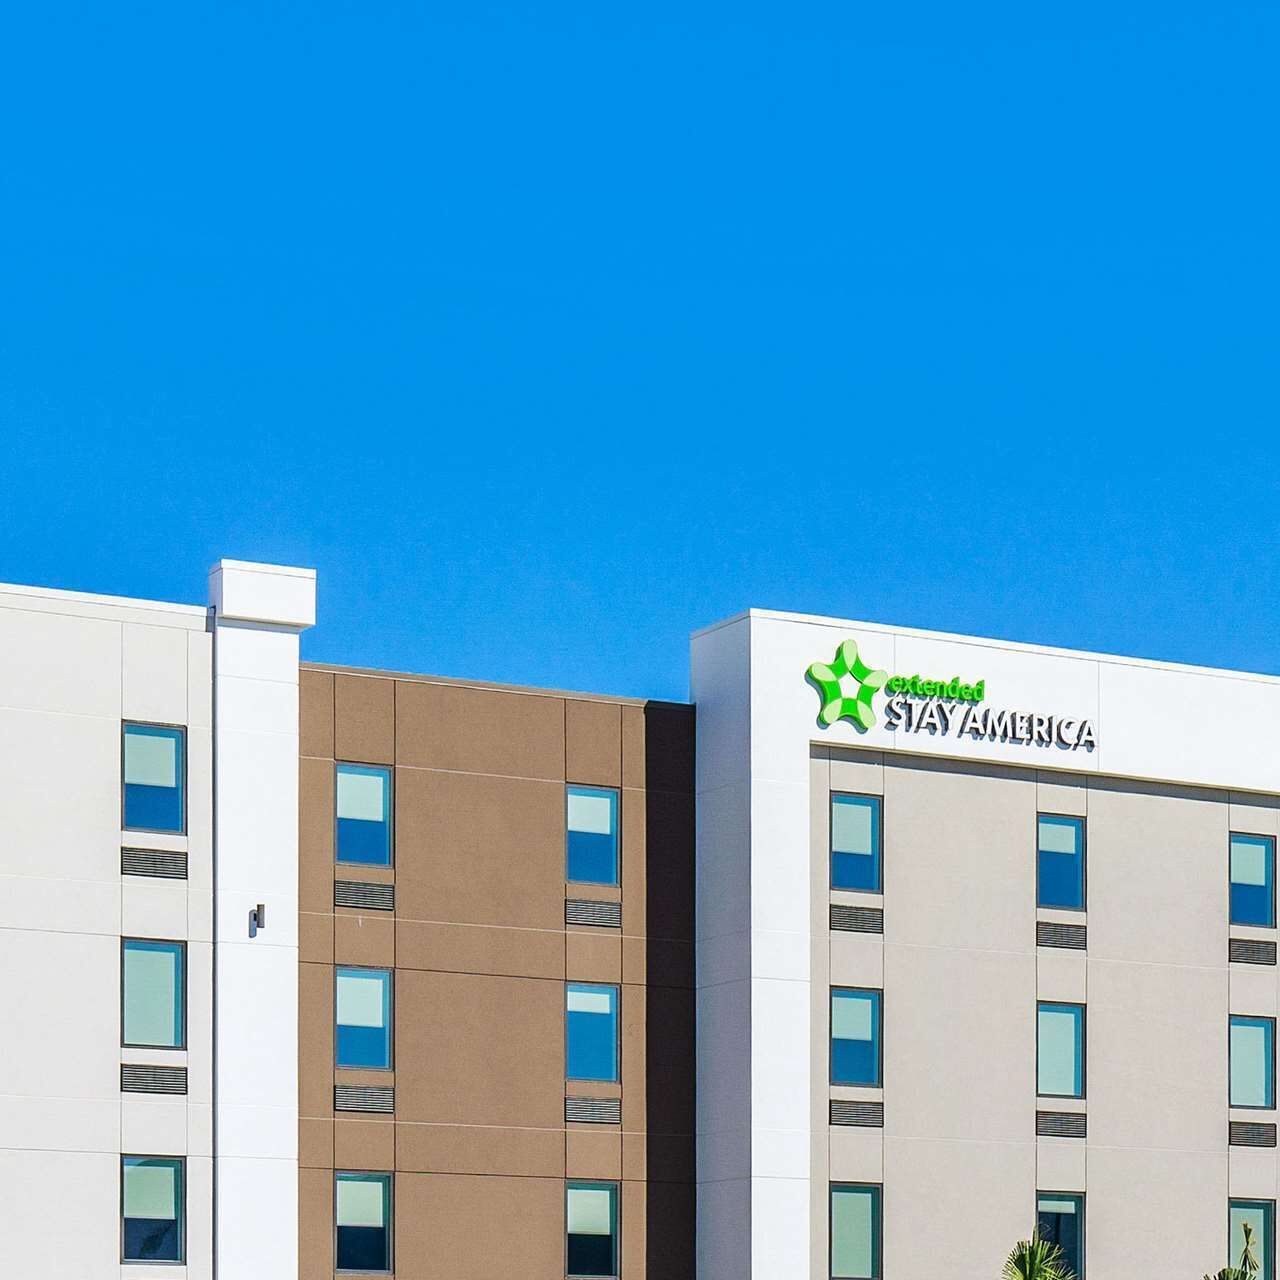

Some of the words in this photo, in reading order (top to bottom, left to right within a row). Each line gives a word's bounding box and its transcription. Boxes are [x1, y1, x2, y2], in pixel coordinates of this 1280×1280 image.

[886, 674, 985, 701] extended
[885, 697, 958, 733] STAY
[961, 701, 1098, 747] AMERICA
